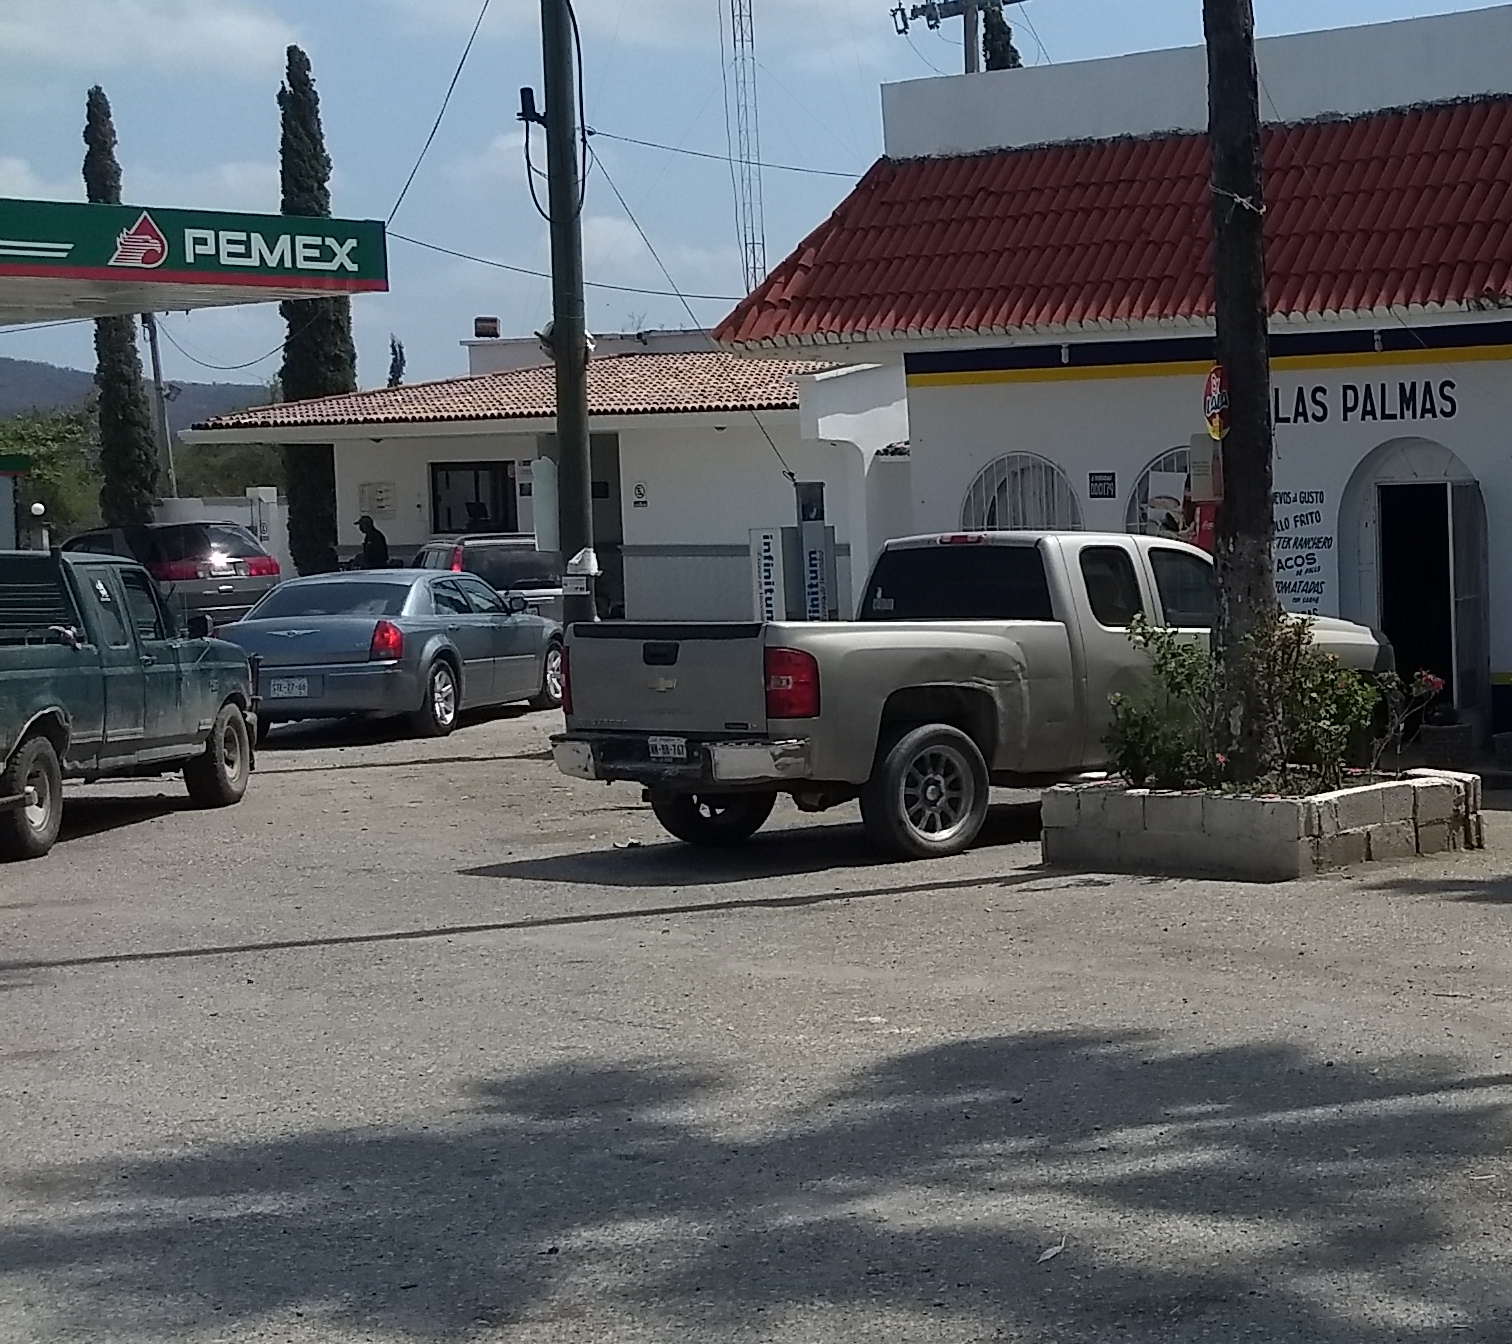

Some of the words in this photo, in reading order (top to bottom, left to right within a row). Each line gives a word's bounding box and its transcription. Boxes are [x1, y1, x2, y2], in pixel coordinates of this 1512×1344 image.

[185, 227, 359, 271] PEMEX
[1274, 385, 1328, 424] LAS
[1342, 379, 1457, 422] PALMAS
[1274, 491, 1292, 505] EVOS
[1299, 490, 1325, 505] GUSTO
[1275, 516, 1290, 533] LLO
[1293, 509, 1322, 529] FRITO
[1276, 536, 1293, 550] TEK
[1292, 536, 1333, 550] RANCHERO
[1276, 552, 1317, 573] ACOS
[808, 550, 819, 620] finitum
[1275, 580, 1326, 595] TOMATADAS
